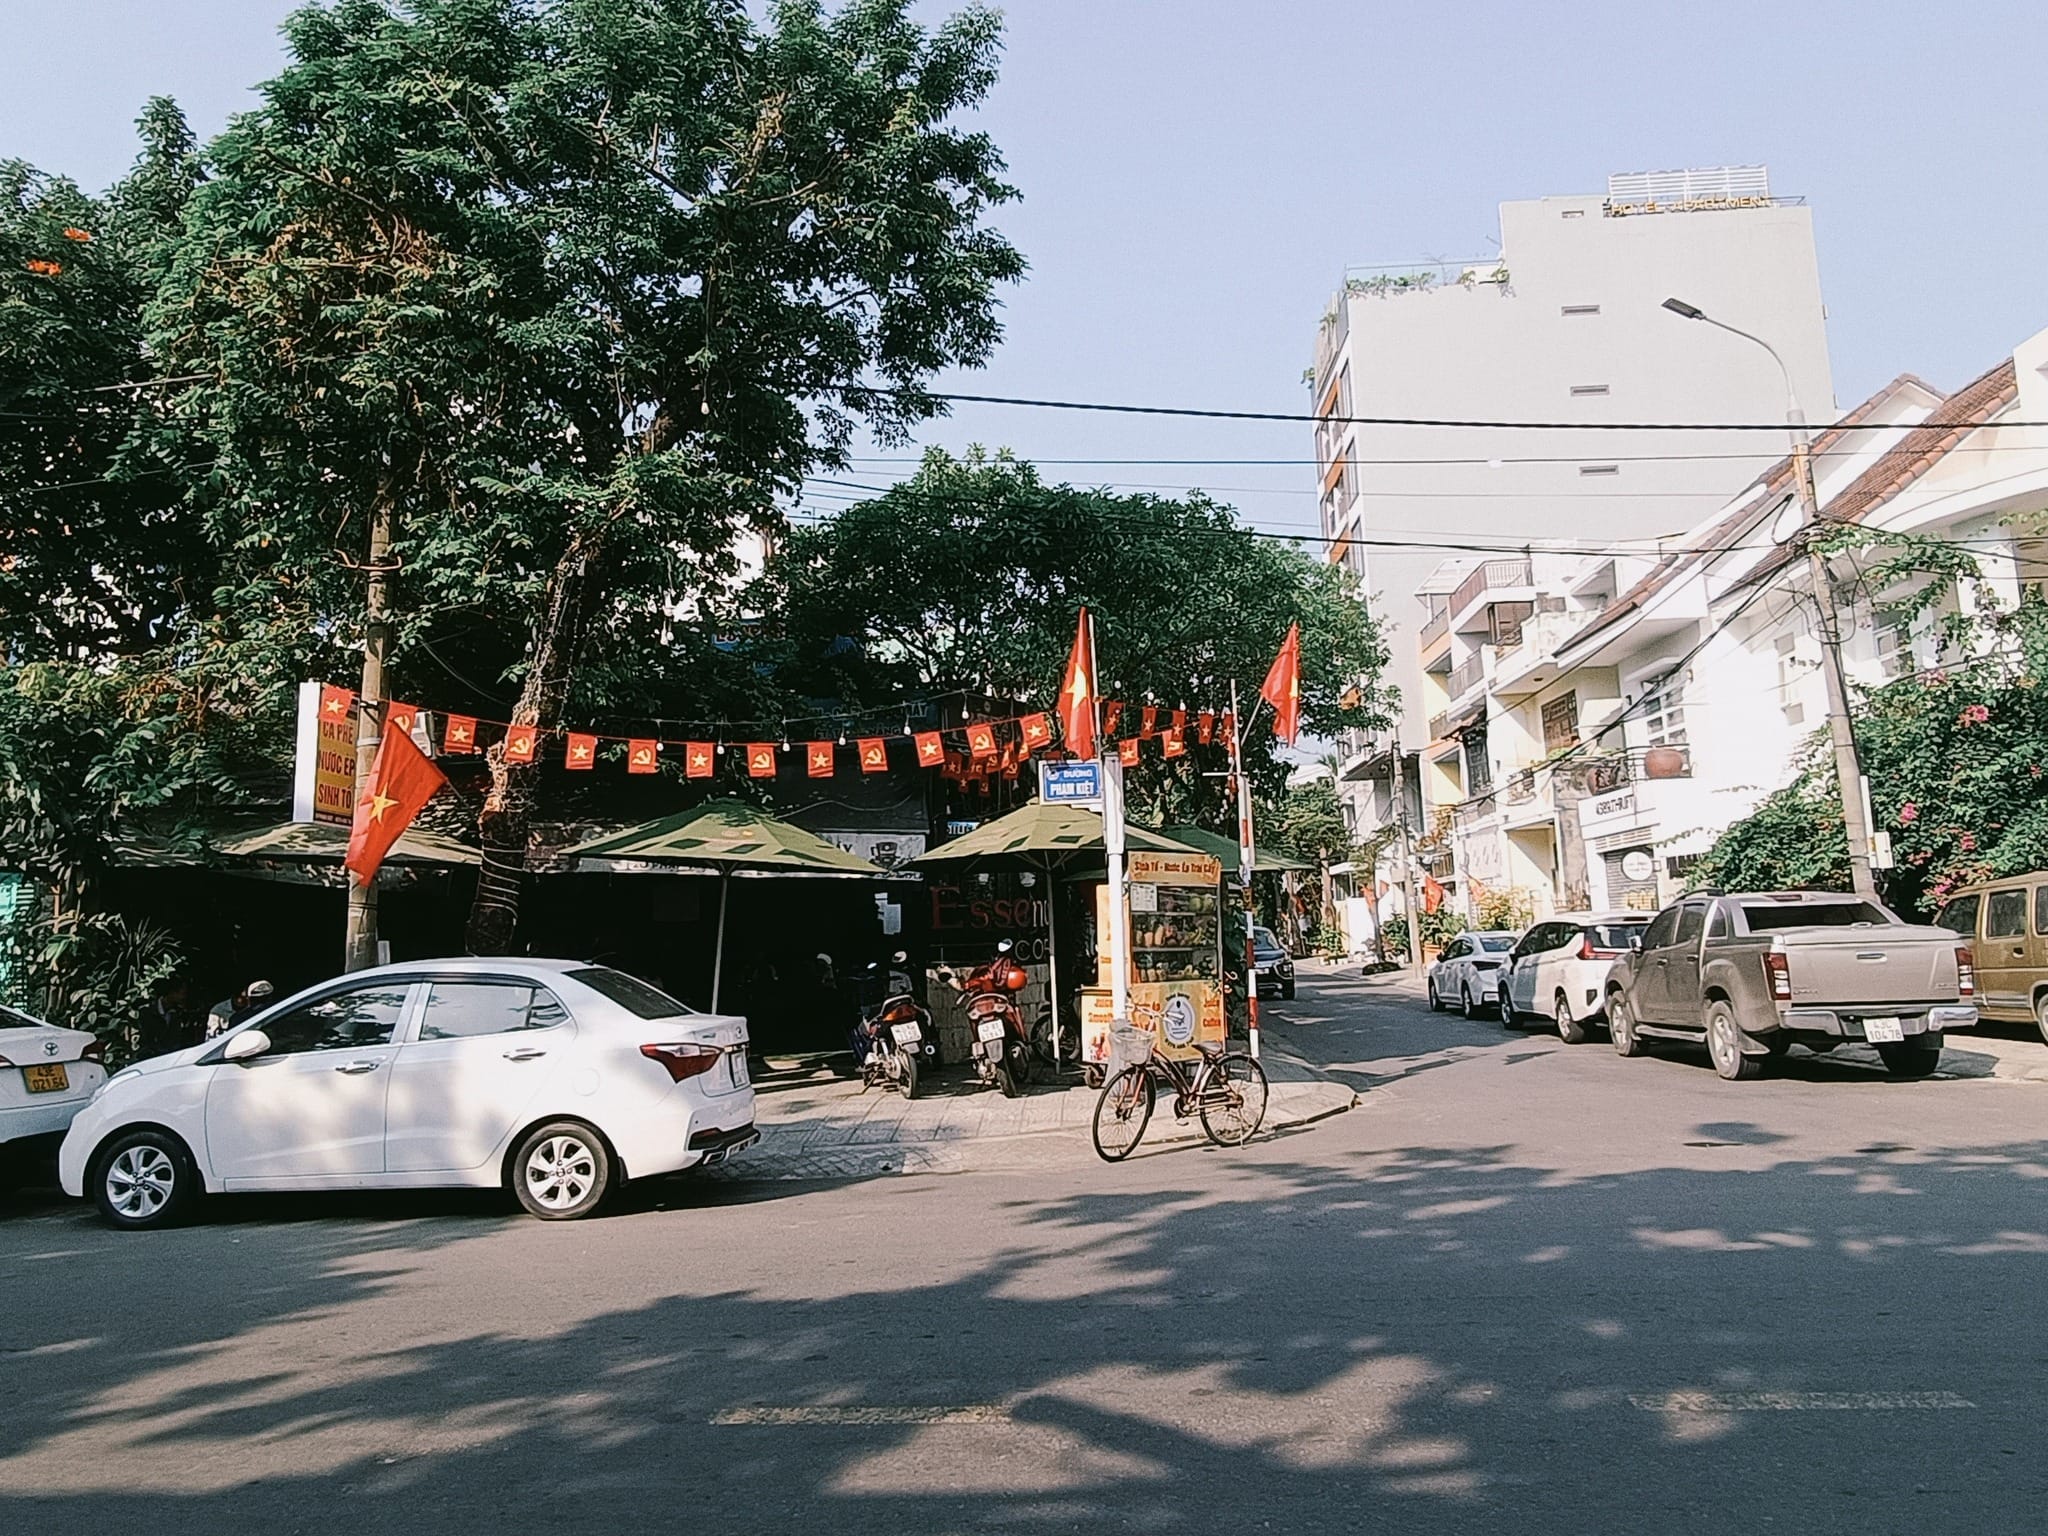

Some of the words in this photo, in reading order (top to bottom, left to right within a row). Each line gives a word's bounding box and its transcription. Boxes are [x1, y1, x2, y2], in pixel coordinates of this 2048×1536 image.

[1611, 201, 1664, 216] HOTEL
[1669, 196, 1771, 212] APARTMENT
[318, 784, 339, 806] SINH
[341, 785, 353, 809] TỐ
